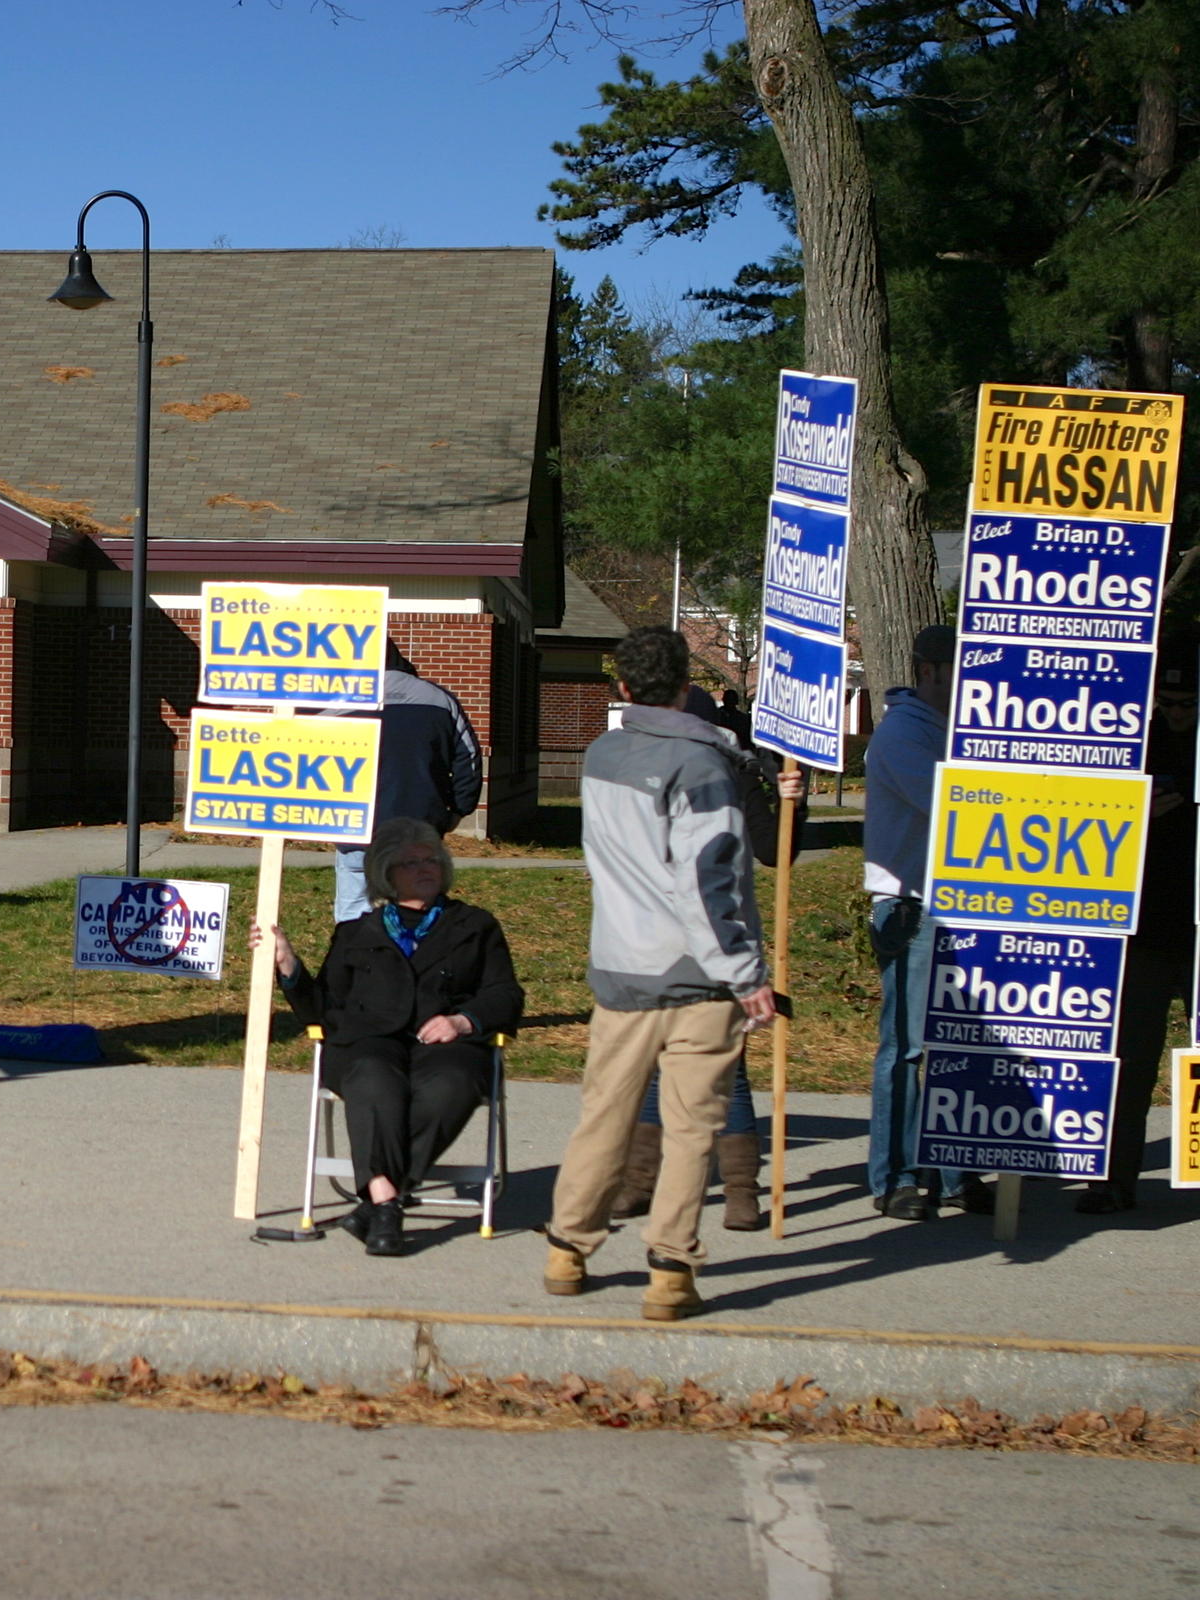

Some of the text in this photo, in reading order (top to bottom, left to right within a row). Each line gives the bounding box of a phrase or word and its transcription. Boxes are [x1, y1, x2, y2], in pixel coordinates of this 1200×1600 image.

[780, 390, 852, 468] Rosenwald
[986, 412, 1170, 454] Fire Fighters
[981, 448, 993, 502] FOR
[996, 450, 1167, 513] HASSAN
[972, 520, 1012, 542] Elect
[1036, 522, 1131, 546] Brian D.
[769, 516, 844, 598] Rosenwald
[968, 553, 1153, 609] Rhodes
[211, 597, 271, 615] Bette
[211, 620, 376, 661] LASKY
[972, 612, 1142, 640] STATE REPRESENTATIVE
[962, 648, 1003, 668] Elect
[1026, 649, 1119, 672] Brian D.
[208, 671, 374, 695] STATE SENATE
[761, 640, 839, 729] Rosenwald
[959, 679, 1141, 735] Rhodes
[200, 724, 261, 744] Bette
[962, 739, 1131, 766] STATE REPRESENTATIVE
[200, 747, 367, 793] LASKY
[950, 785, 1004, 805] Bette
[194, 799, 364, 828] STATE SENATE
[944, 810, 1133, 877] LASKY
[122, 882, 180, 906] NO
[934, 886, 1129, 922] State Senate
[938, 933, 977, 953] Elect
[1000, 934, 1091, 959] Brian D.
[173, 959, 215, 971] POINT
[932, 964, 1112, 1020] Rhodes
[935, 1021, 1102, 1050] STATE REPRESENTATIVE
[992, 1058, 1084, 1082] Brian D.
[926, 1087, 1104, 1142] Rhodes
[929, 1143, 1095, 1173] STATE REPRESENTATIVE
